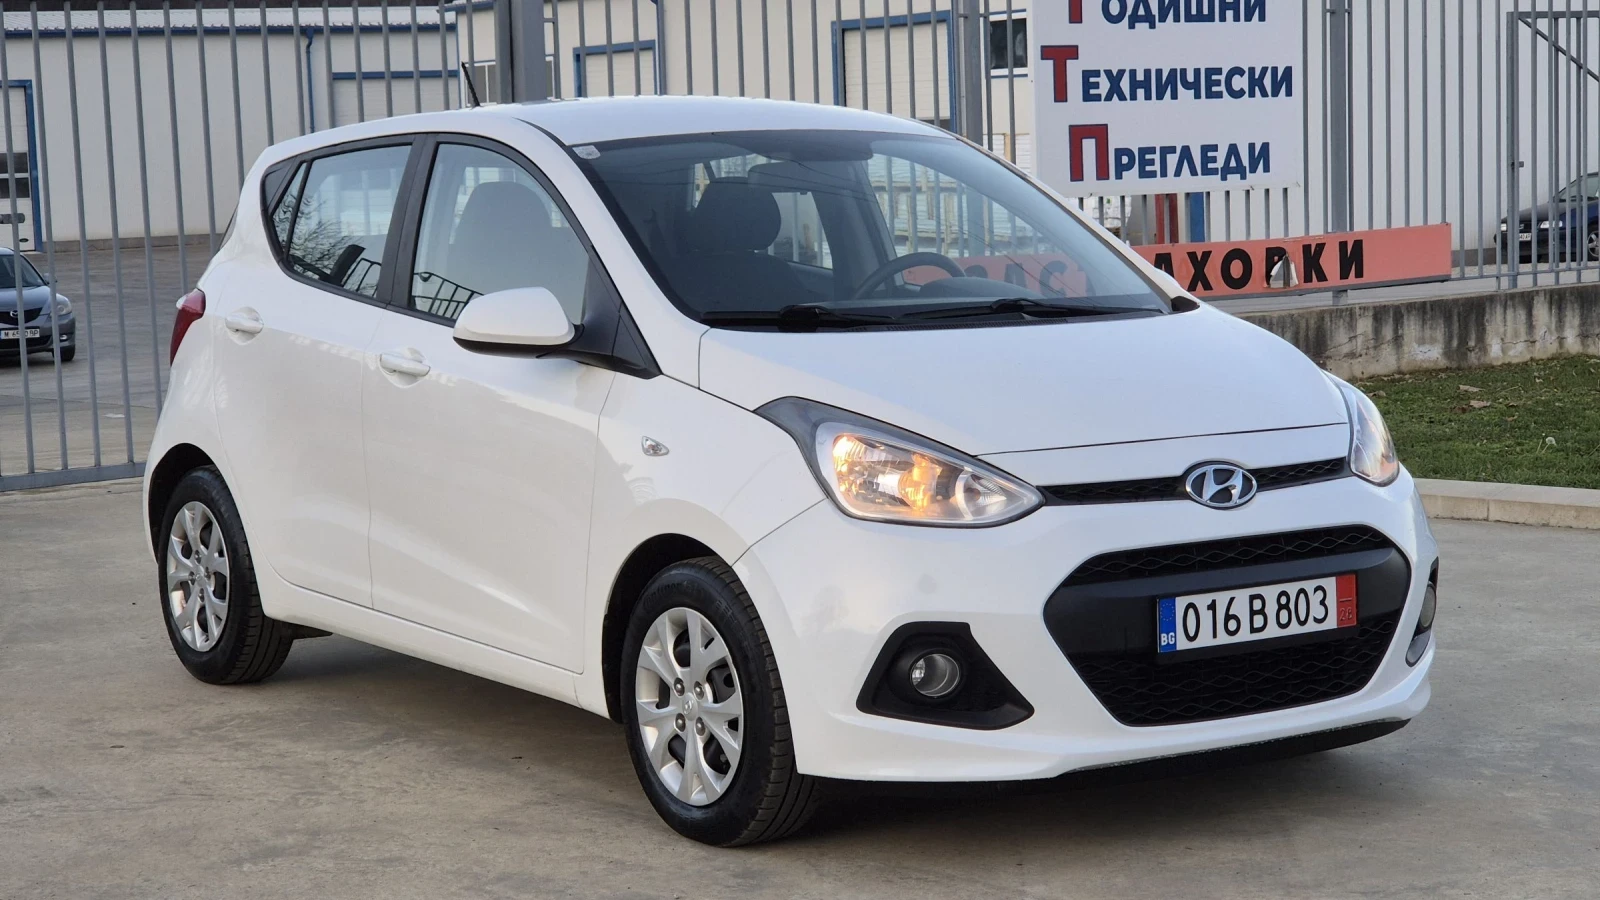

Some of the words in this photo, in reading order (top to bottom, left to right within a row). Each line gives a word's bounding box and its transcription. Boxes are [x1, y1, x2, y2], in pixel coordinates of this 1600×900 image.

[1040, 45, 1293, 102] ТЕХНИЧЕСКИ
[1068, 124, 1271, 182] ПРЕГЛЕДИ
[1160, 632, 1175, 645] BG
